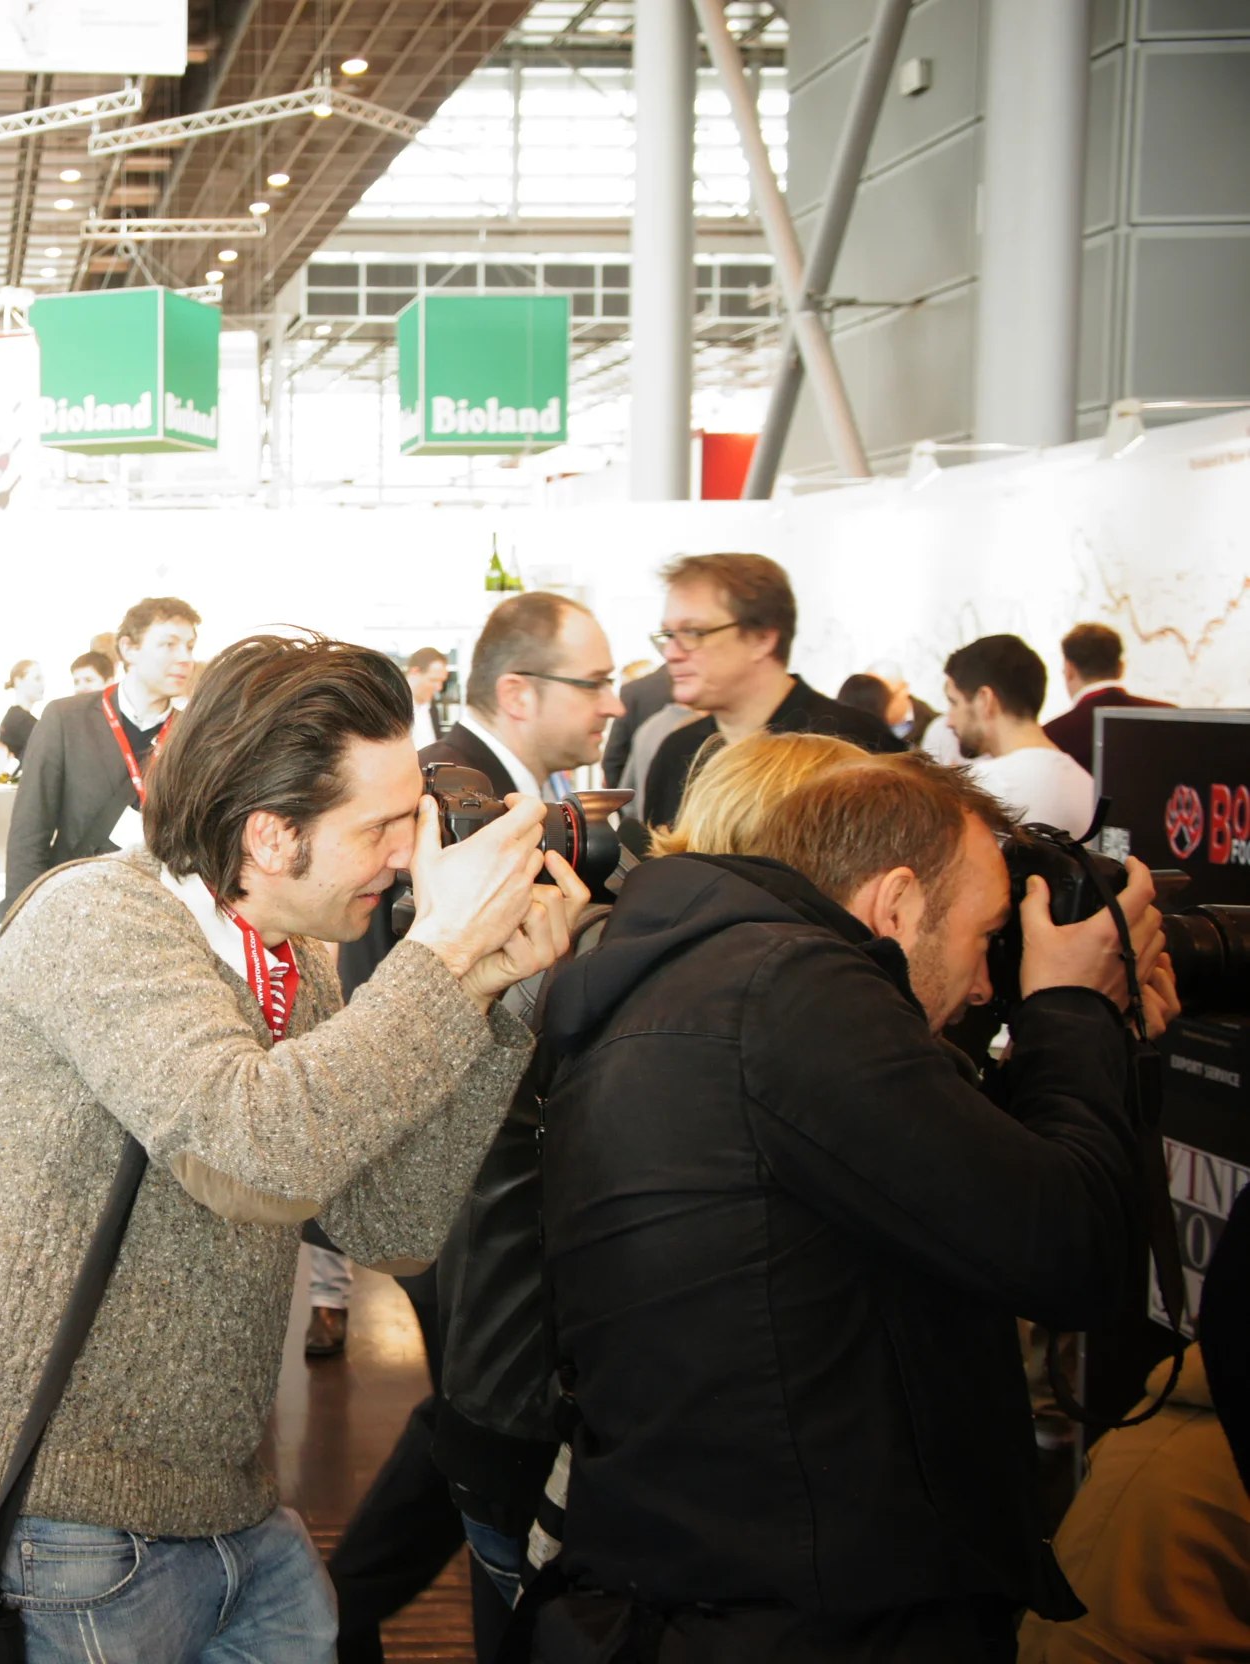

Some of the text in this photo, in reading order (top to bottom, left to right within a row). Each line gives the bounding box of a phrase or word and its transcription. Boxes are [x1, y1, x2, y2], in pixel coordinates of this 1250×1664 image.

[40, 391, 153, 434] Bioland
[431, 396, 561, 434] Bioland
[249, 930, 264, 1006] www.prowein.com
[1171, 1054, 1241, 1088] EXPORT SERVICE
